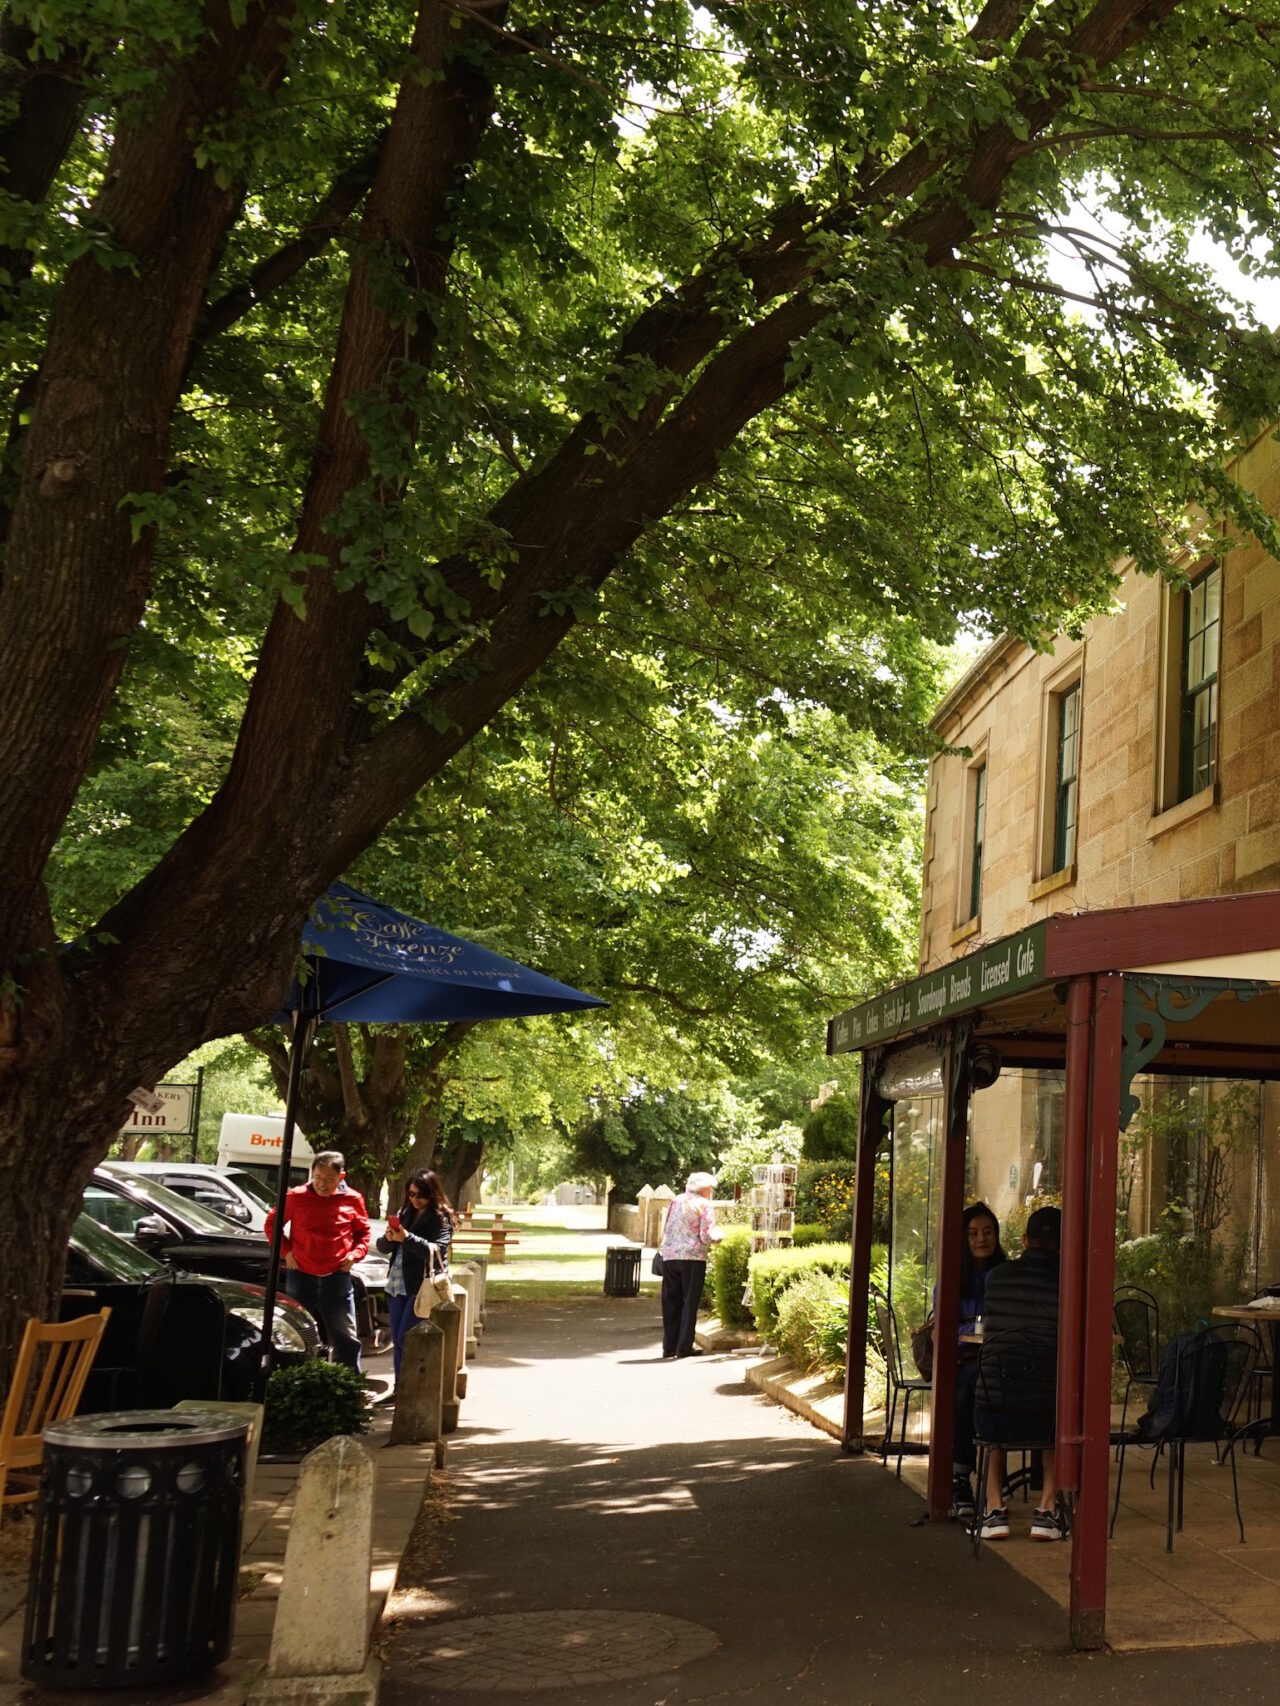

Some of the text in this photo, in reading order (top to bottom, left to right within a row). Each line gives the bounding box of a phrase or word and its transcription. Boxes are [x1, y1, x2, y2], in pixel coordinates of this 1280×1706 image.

[896, 996, 911, 1025] Juies
[917, 976, 947, 1017] Sourdough
[950, 965, 971, 1005] Breads
[980, 947, 1010, 992] Licensed
[131, 1111, 167, 1127] Inn
